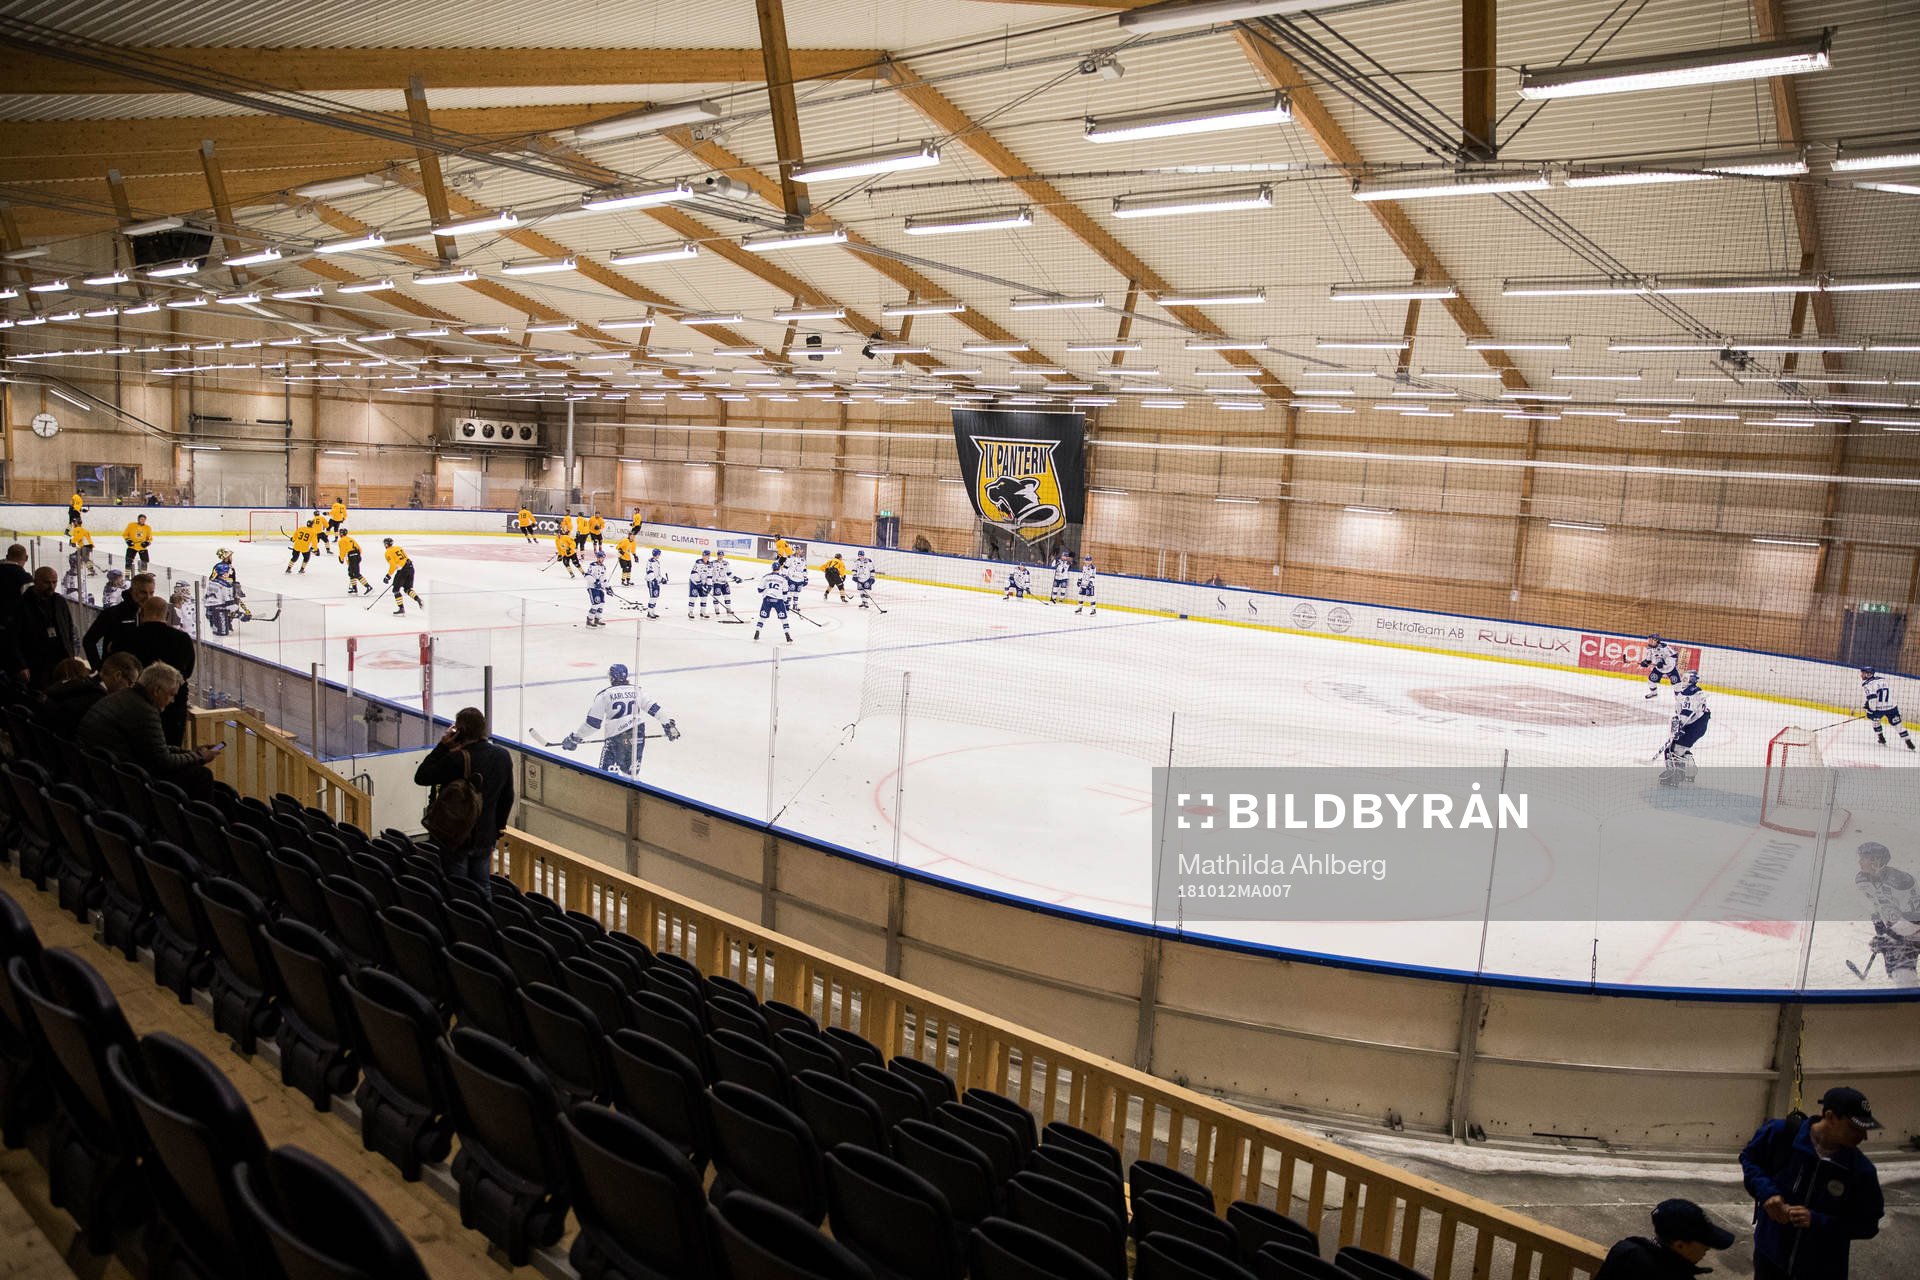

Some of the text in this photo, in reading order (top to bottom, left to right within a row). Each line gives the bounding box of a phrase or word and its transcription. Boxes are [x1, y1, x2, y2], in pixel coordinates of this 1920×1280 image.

[984, 443, 1049, 478] IK PANTERN
[297, 531, 310, 542] 39
[1376, 618, 1445, 637] ElektroTeam
[1448, 627, 1465, 639] AB
[610, 691, 637, 701] KARLSSO
